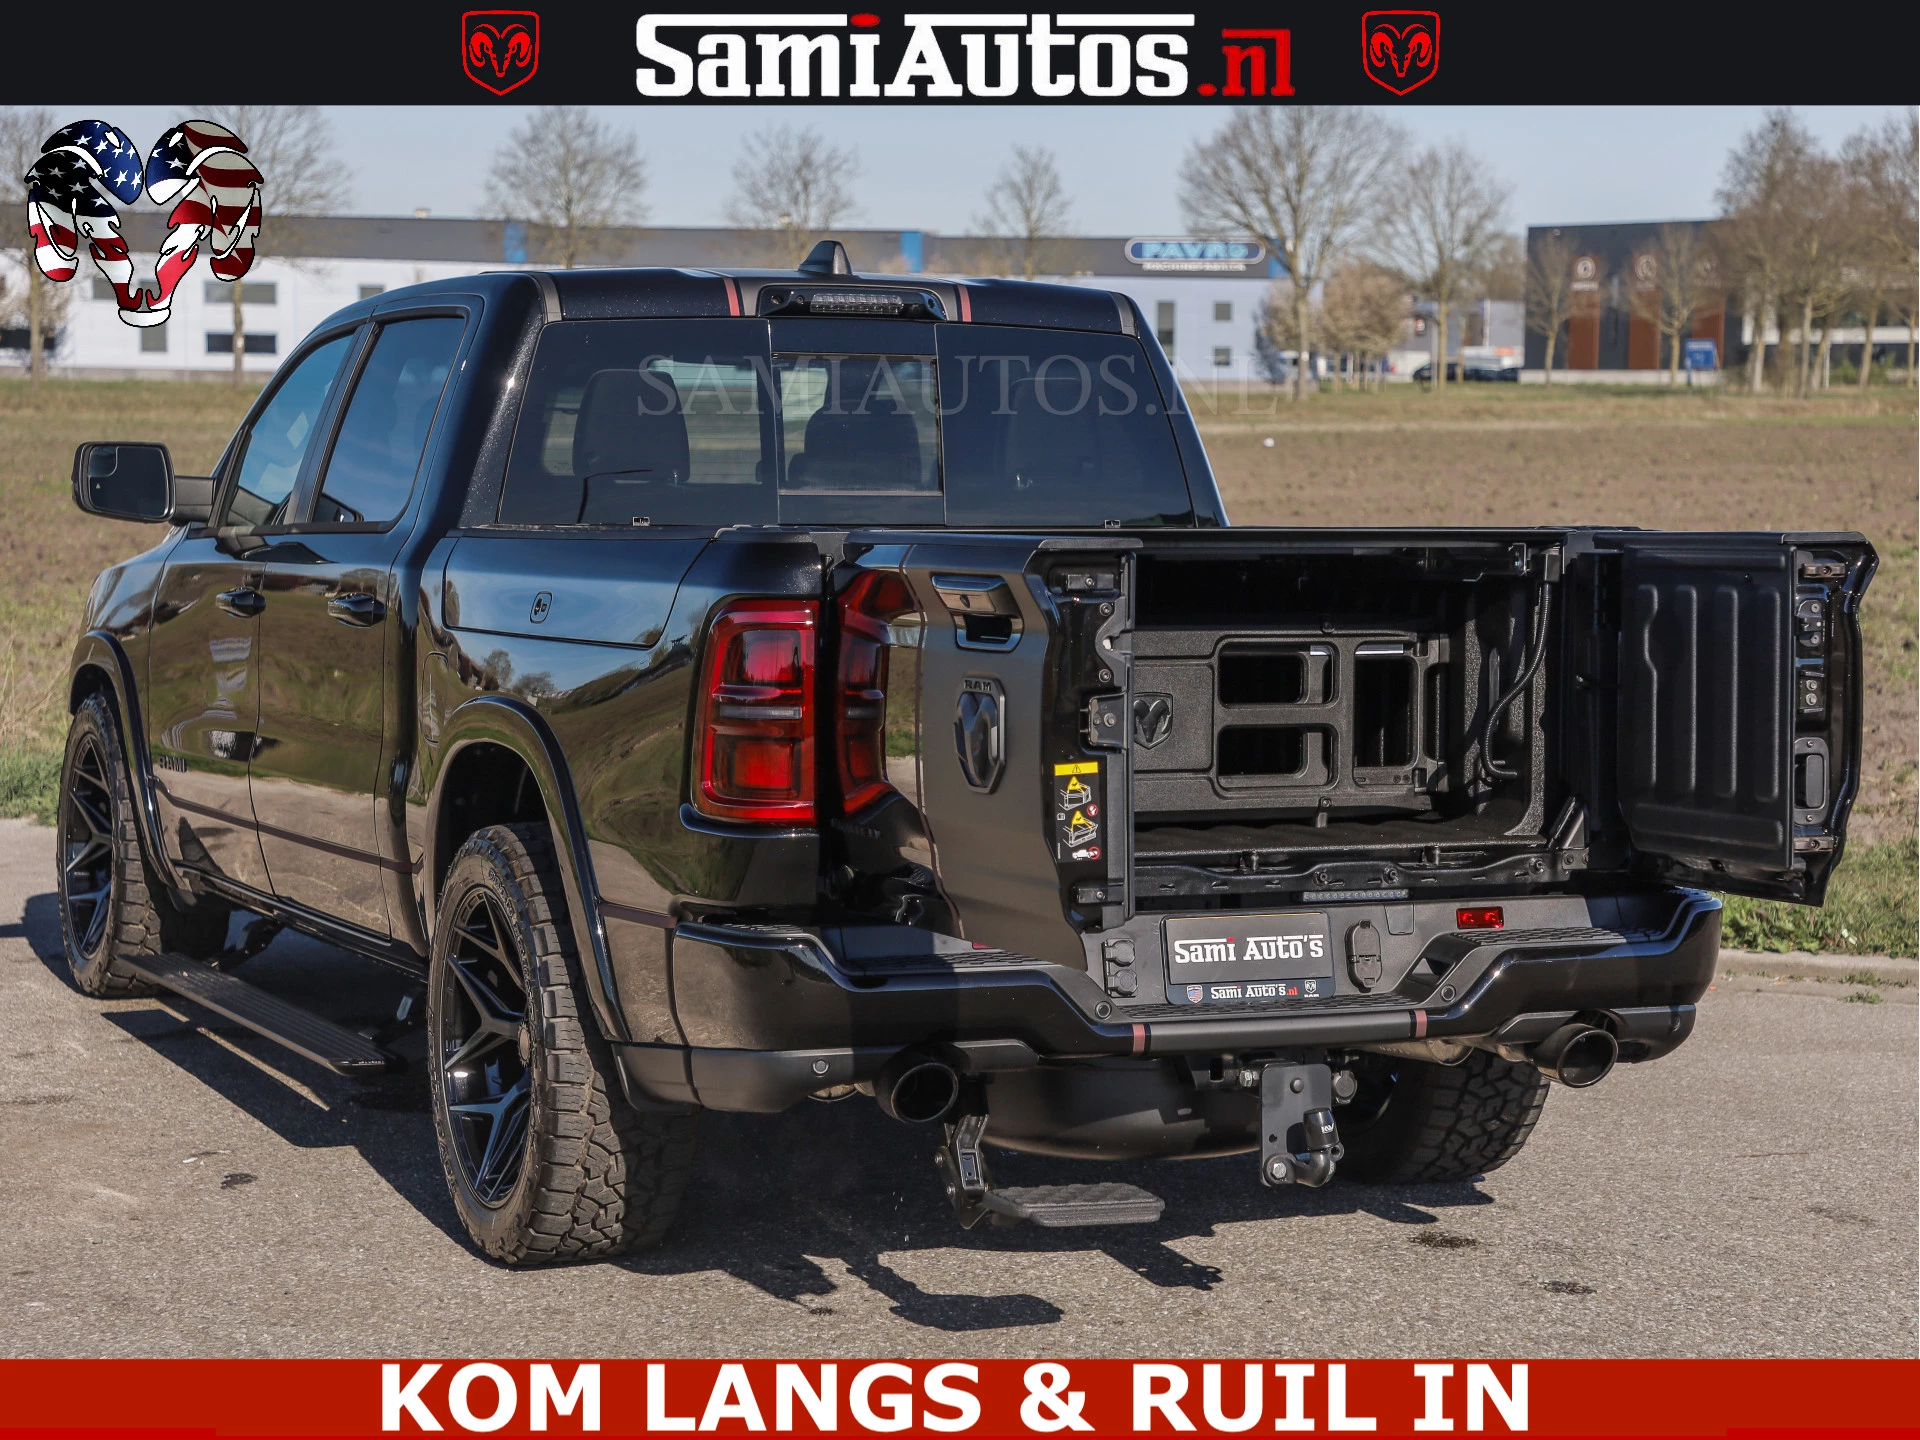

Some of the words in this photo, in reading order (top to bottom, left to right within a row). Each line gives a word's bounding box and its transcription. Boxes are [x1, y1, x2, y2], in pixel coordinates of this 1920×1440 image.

[963, 679, 992, 692] RAM
[158, 755, 187, 773] RAM
[1174, 937, 1236, 964] Sami
[1243, 934, 1324, 961] Auto's
[1210, 985, 1242, 1000] Sami
